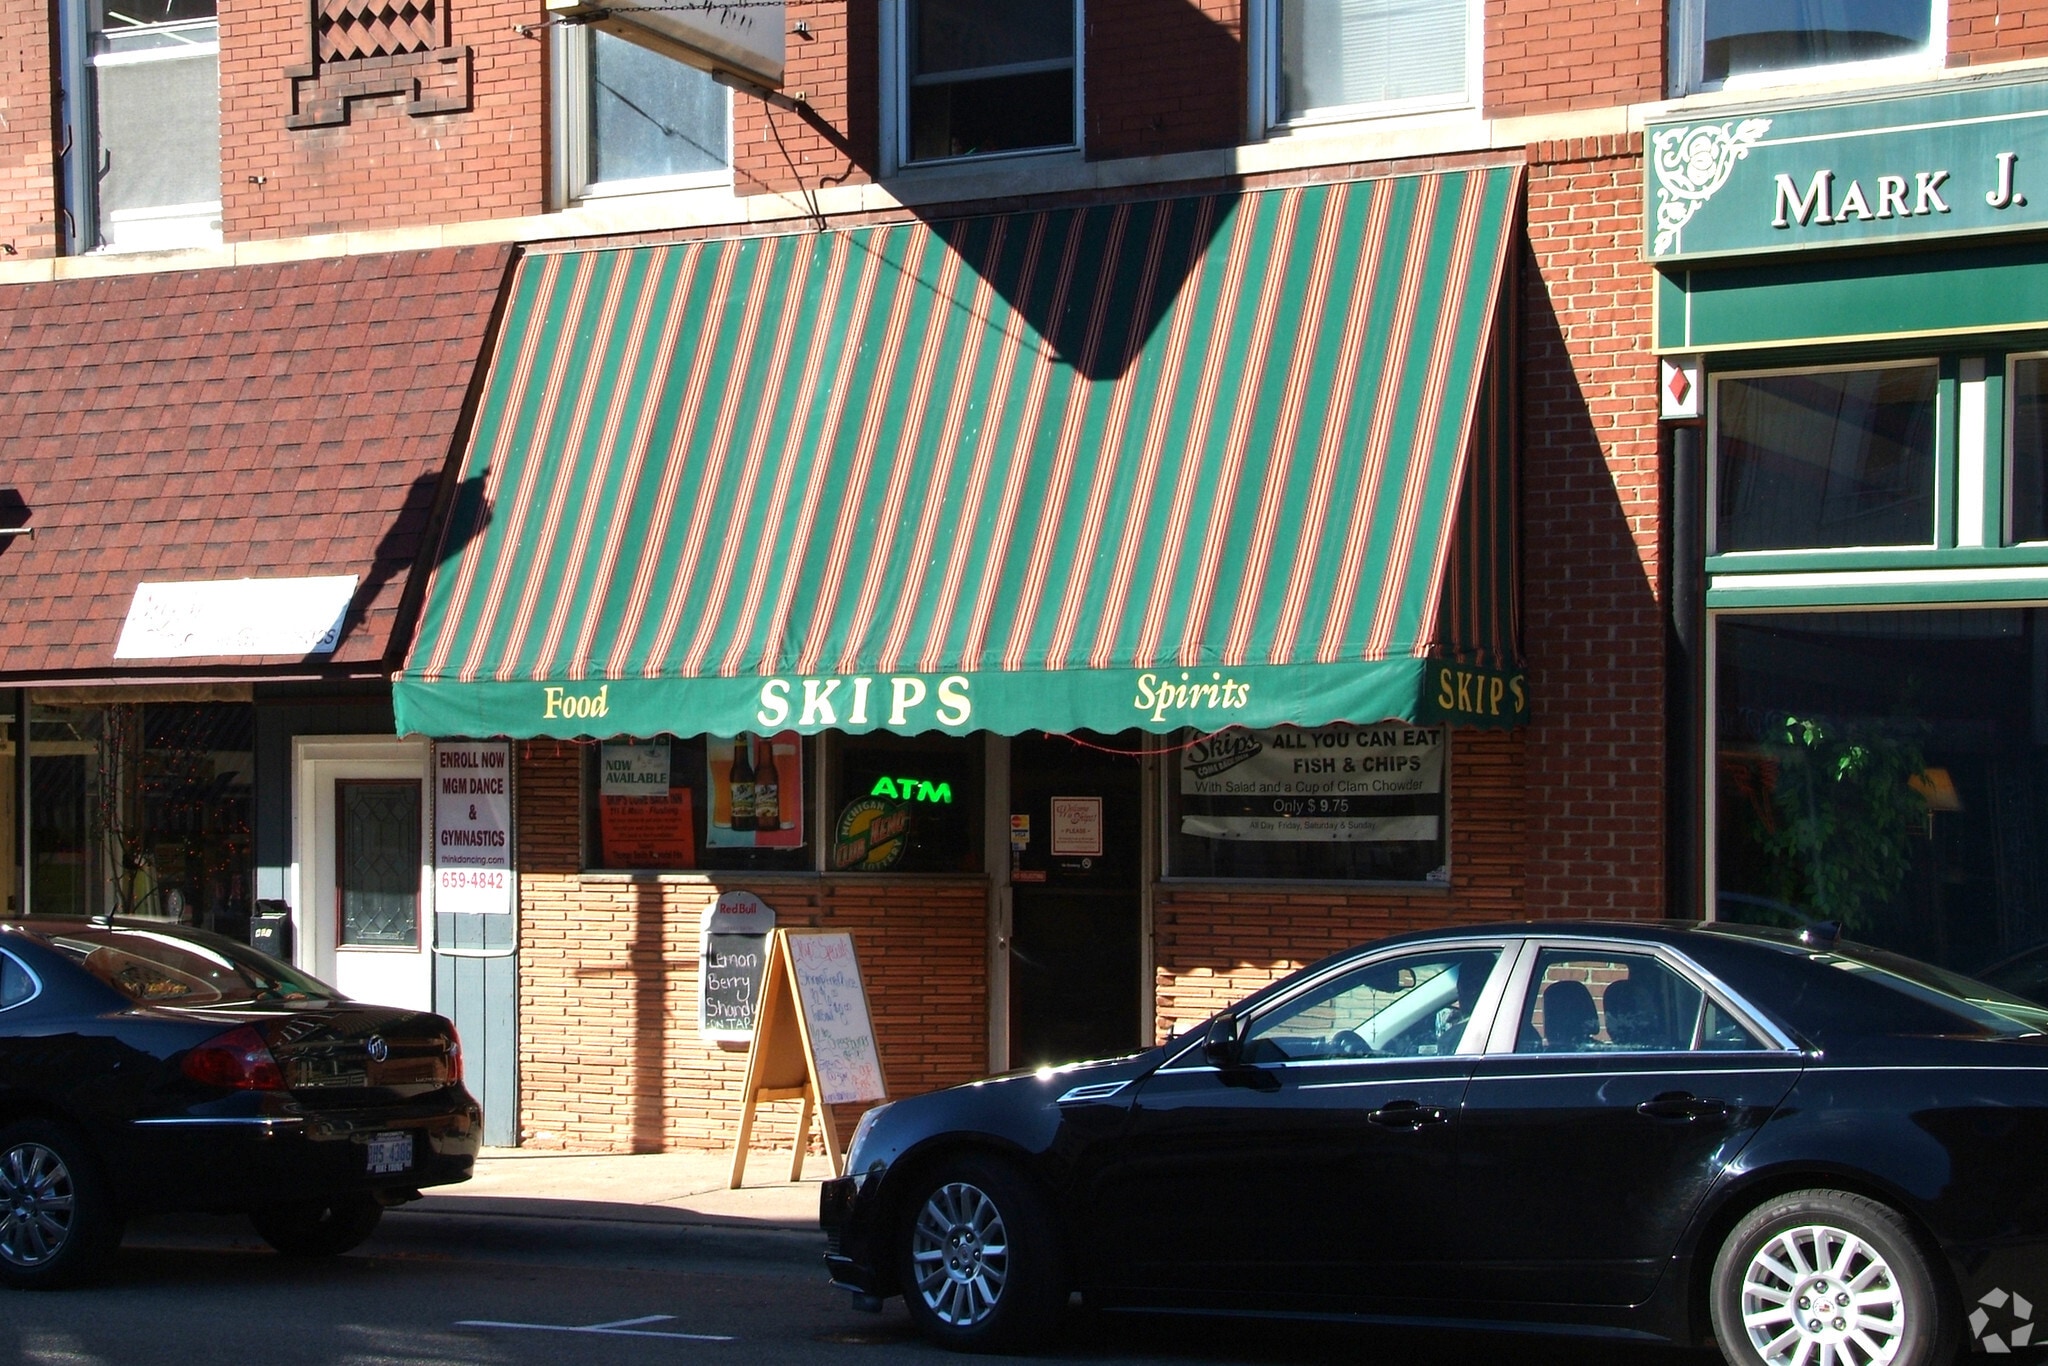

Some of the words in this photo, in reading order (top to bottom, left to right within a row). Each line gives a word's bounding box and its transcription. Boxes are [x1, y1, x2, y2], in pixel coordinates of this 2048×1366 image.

[1771, 169, 1950, 229] MARK
[1985, 152, 2027, 209] J.
[1134, 671, 1249, 722] Spirits
[1438, 668, 1525, 716] SKIPS
[543, 685, 609, 720] Food
[757, 675, 973, 727] SKIPS
[1272, 733, 1306, 749] ALL
[1312, 732, 1349, 748] YOU
[1356, 731, 1396, 747] CAN
[1403, 730, 1440, 746] EAT
[440, 752, 478, 768] ENROLL
[482, 752, 505, 768] NOW
[605, 760, 632, 771] NOW
[1293, 758, 1336, 774] FISH
[1343, 757, 1356, 773] &
[1362, 756, 1421, 772] CHIPS
[442, 778, 467, 794] MGM
[470, 778, 503, 794] DANCE
[605, 773, 667, 784] AVAILABLE
[1195, 780, 1222, 793] With
[1225, 781, 1256, 793] Salad
[1259, 781, 1279, 793] and
[1284, 784, 1292, 793] a
[1295, 782, 1319, 795] Cup
[1322, 780, 1334, 792] of
[1337, 780, 1369, 792] Clam
[1372, 779, 1423, 792] Chowder
[871, 776, 952, 804] ATM
[468, 804, 477, 820] &
[1273, 799, 1304, 814] Only
[1307, 799, 1316, 813] $
[1320, 799, 1349, 813] 9.75
[841, 800, 885, 836] MICHIGAN
[1260, 822, 1275, 831] Day
[1304, 821, 1339, 831] Saturday
[1348, 821, 1376, 831] Sunday
[441, 830, 505, 847] GYMNASTICS
[441, 855, 505, 866] thinkdancing.com
[442, 872, 503, 889] 659-4842
[708, 943, 757, 968] Lemon
[708, 973, 750, 1002] Berry
